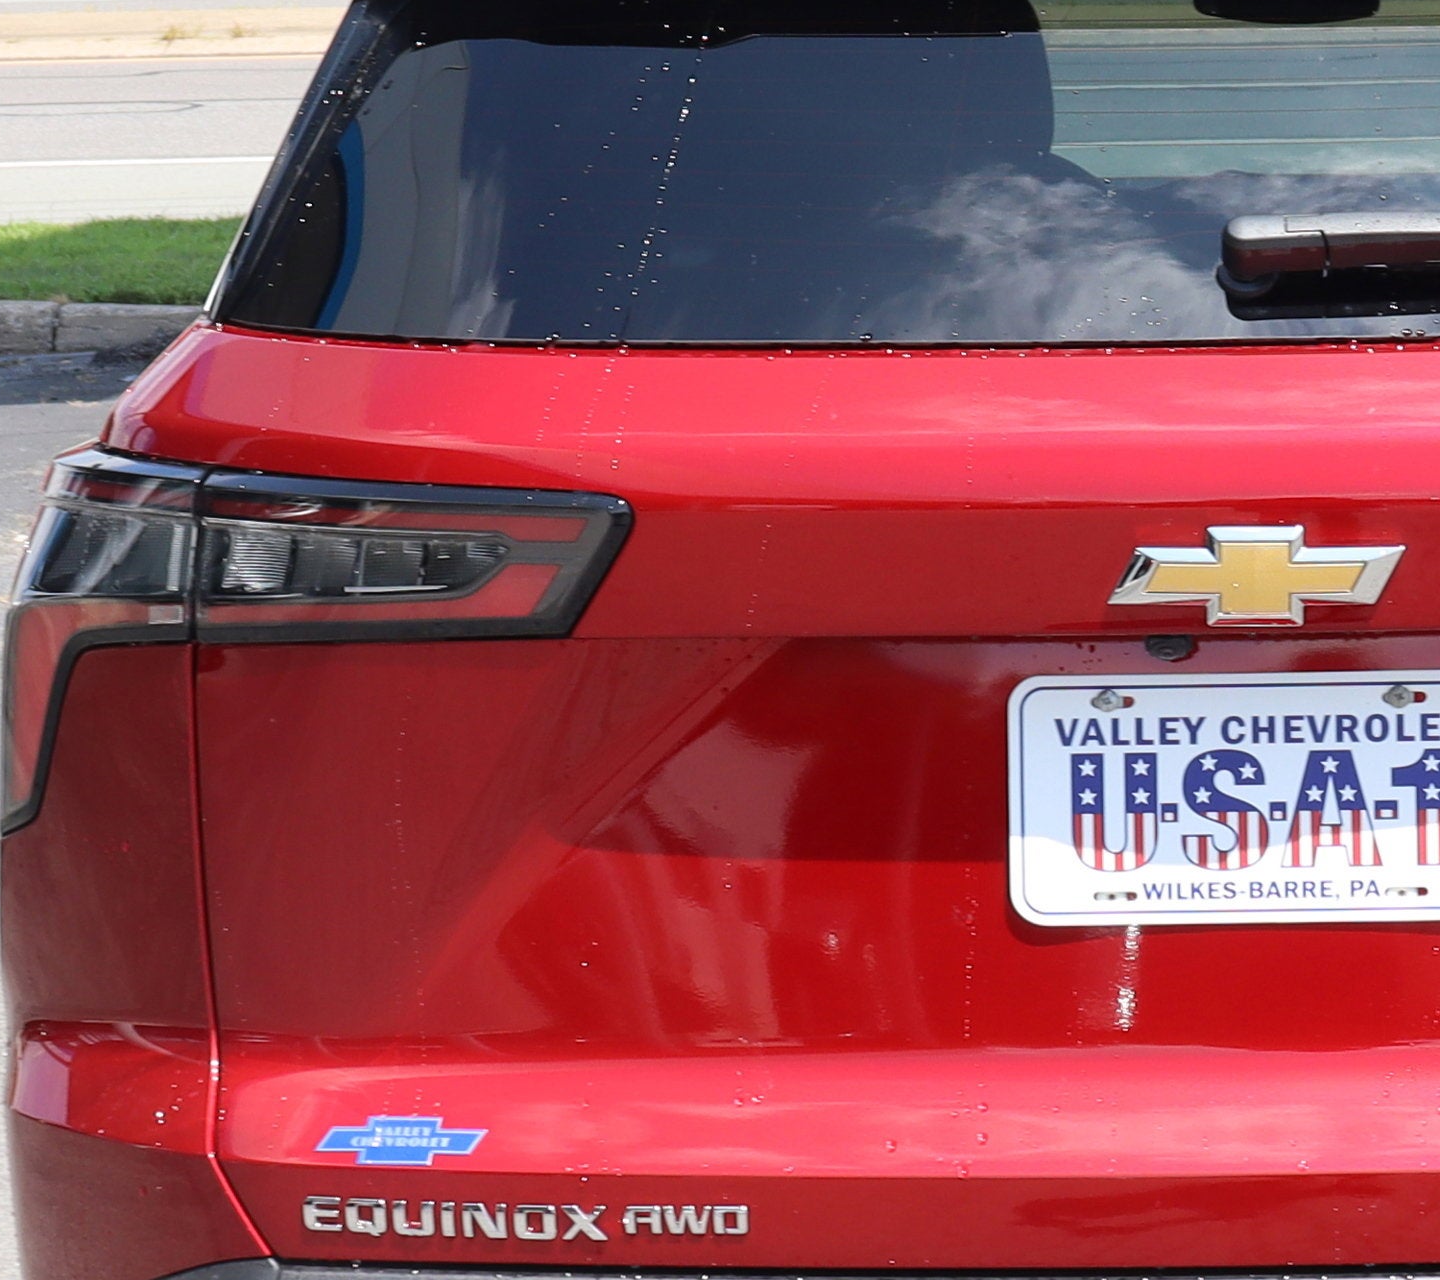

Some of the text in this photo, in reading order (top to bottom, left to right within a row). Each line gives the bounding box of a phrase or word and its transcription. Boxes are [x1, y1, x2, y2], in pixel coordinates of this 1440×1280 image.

[1055, 716, 1207, 747] VALLEY
[1142, 880, 1380, 901] WILKES-BARRE, PA
[302, 1195, 750, 1242] EQUINOX AWD
